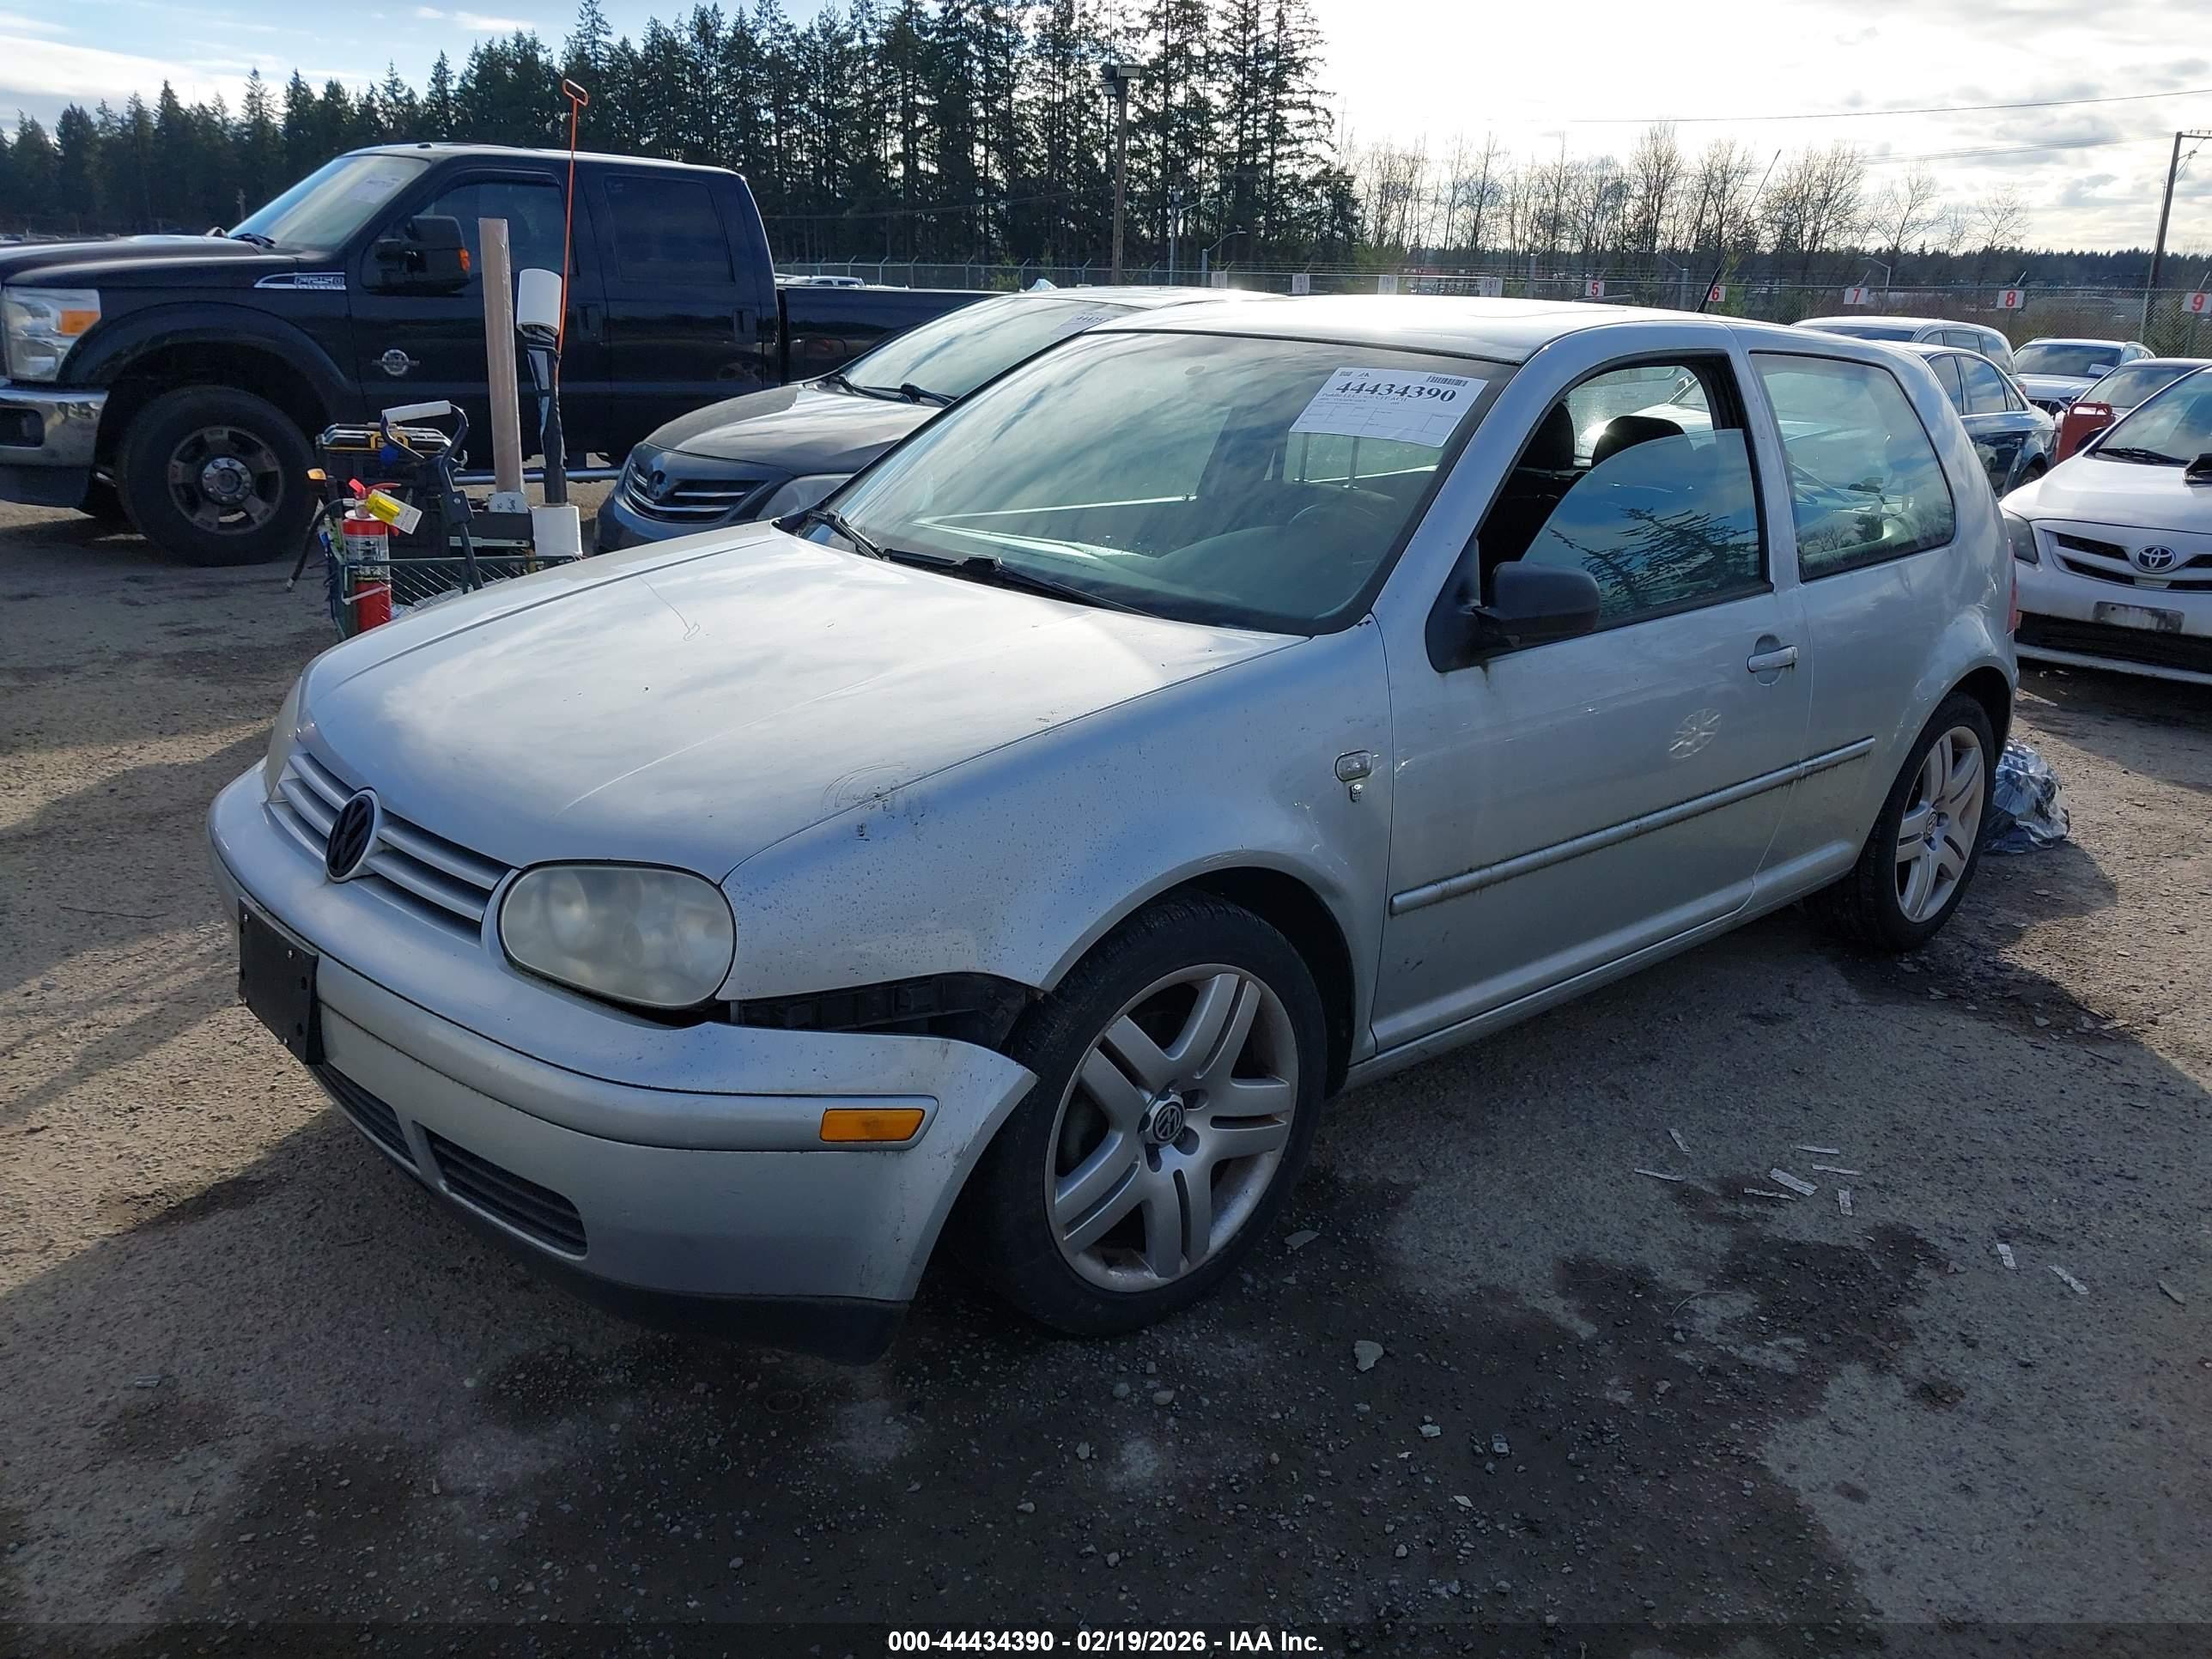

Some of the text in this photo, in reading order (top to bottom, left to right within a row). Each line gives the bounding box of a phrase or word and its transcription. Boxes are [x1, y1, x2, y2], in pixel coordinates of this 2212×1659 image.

[1591, 282, 1599, 296] 5
[1711, 286, 1721, 301] 6
[1851, 289, 1861, 303] 7
[2005, 292, 2016, 307] 8
[2191, 295, 2205, 311] 9
[1336, 380, 1457, 403] 44434390
